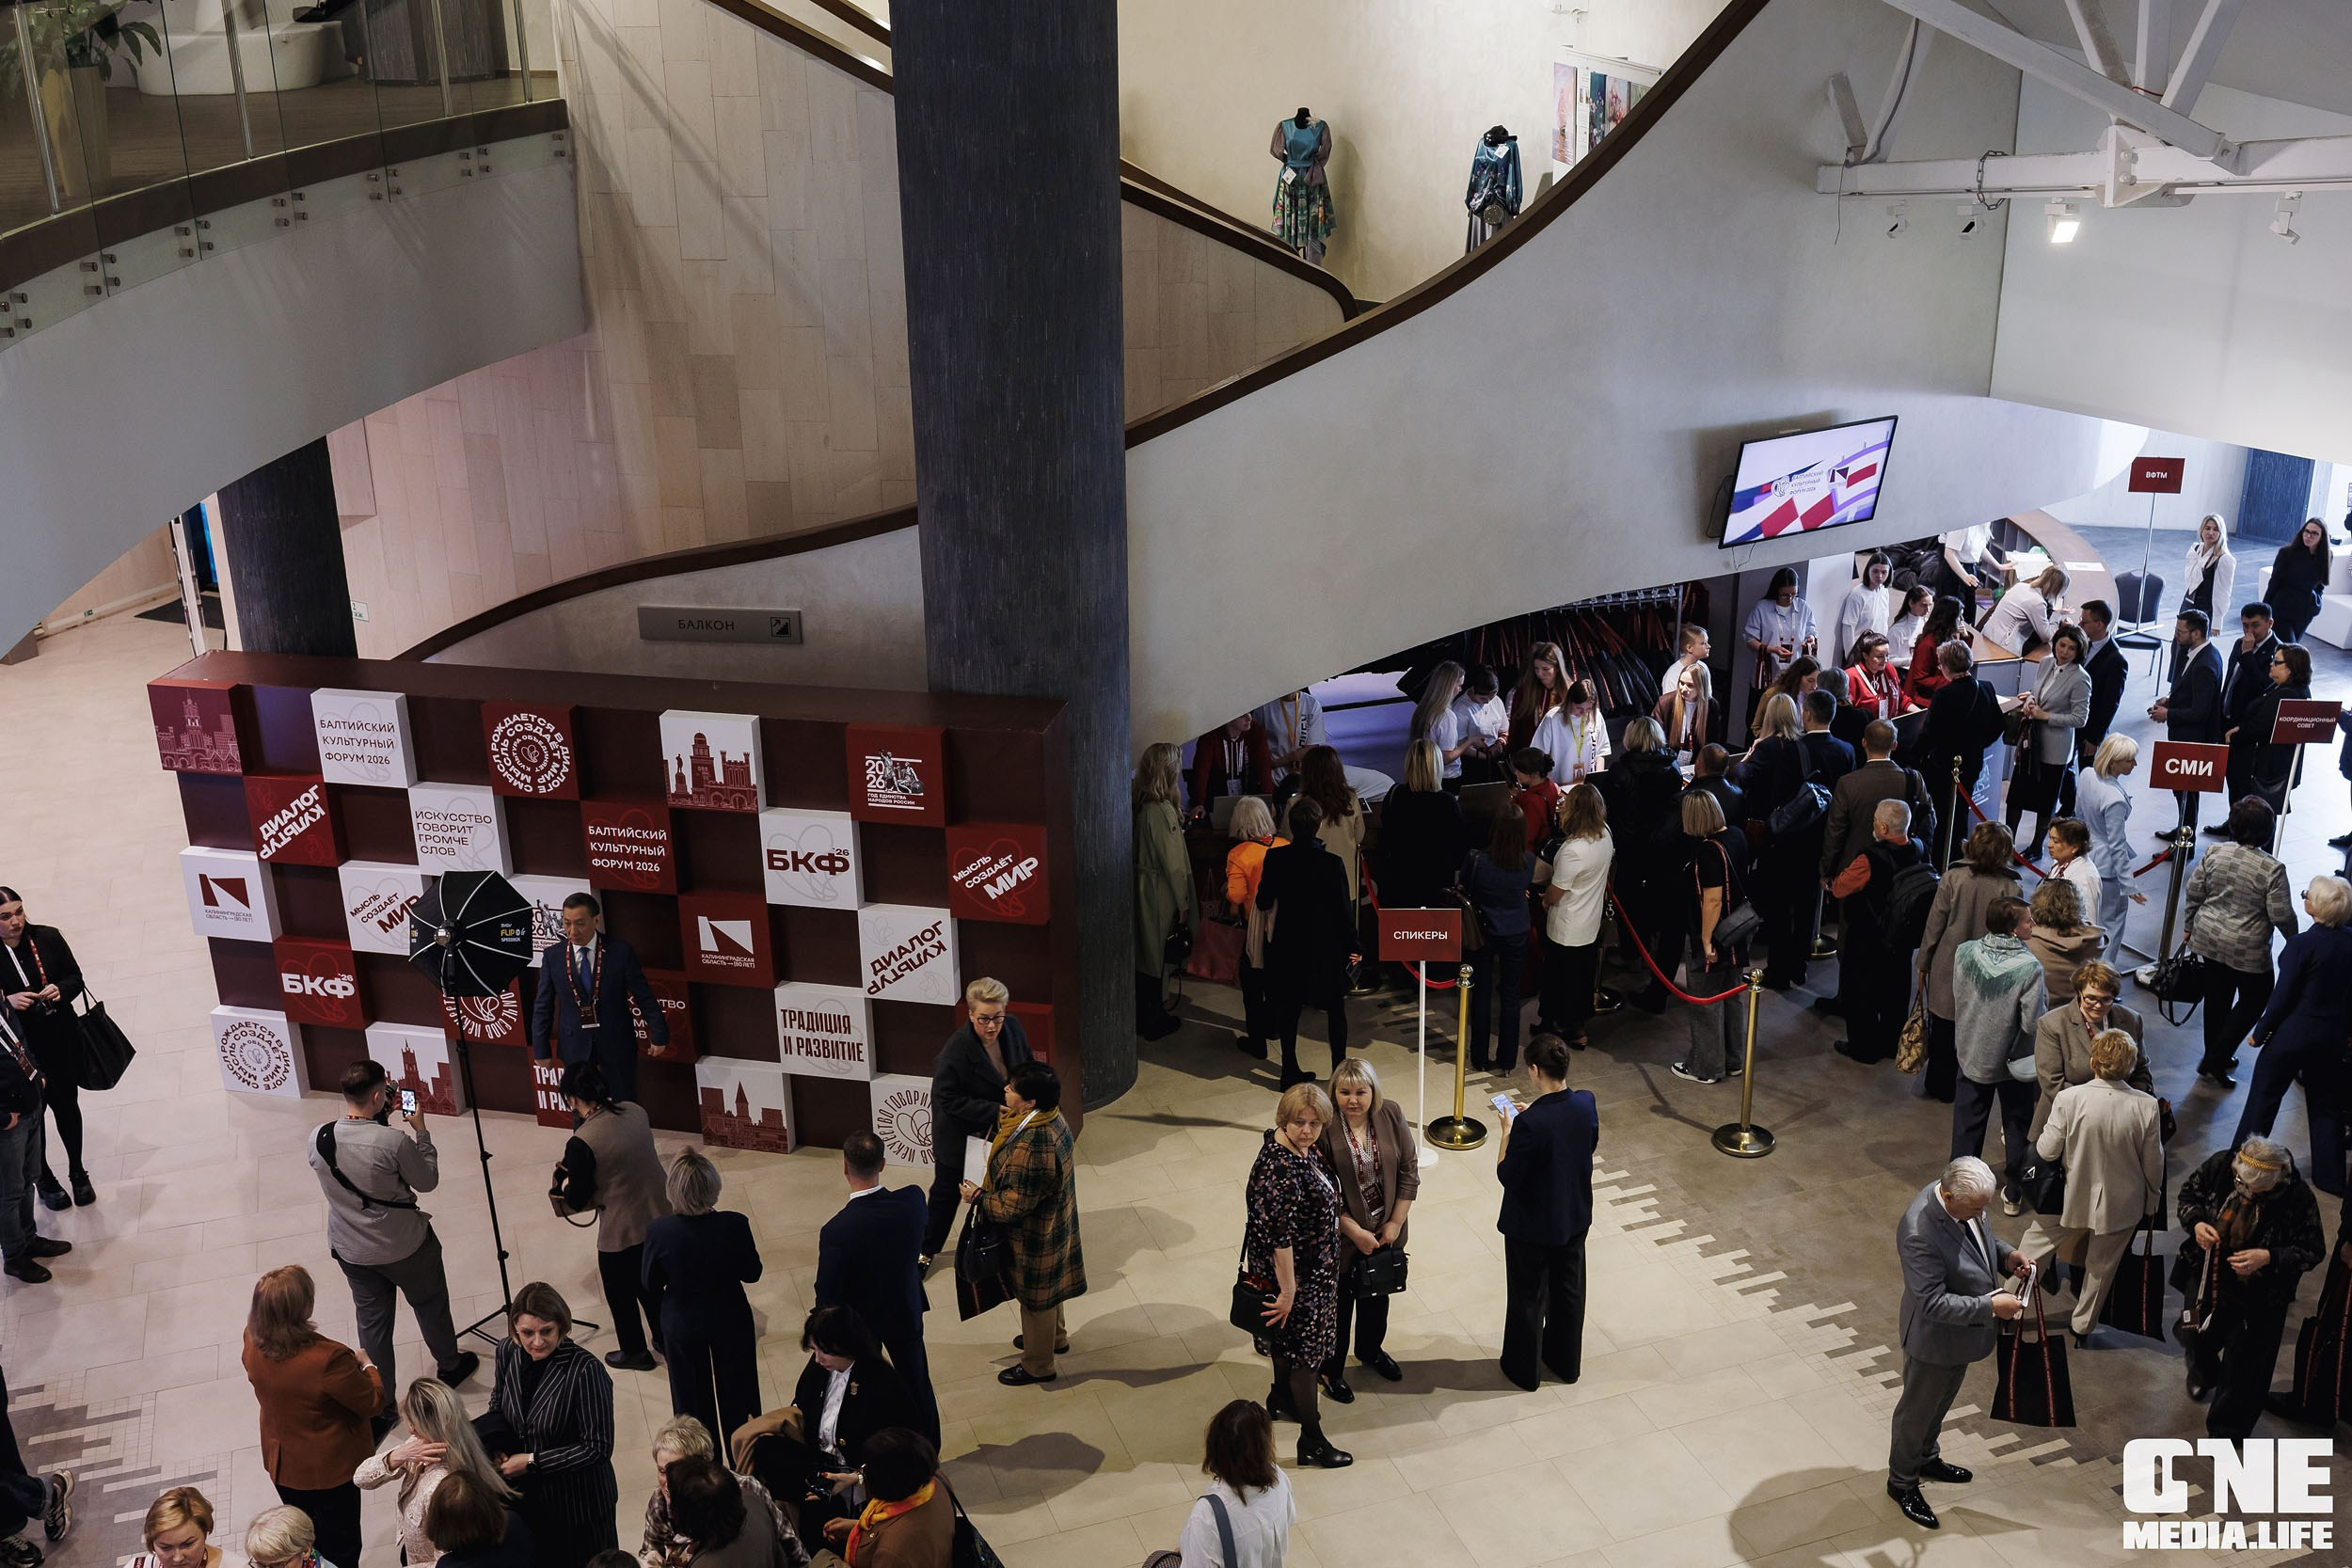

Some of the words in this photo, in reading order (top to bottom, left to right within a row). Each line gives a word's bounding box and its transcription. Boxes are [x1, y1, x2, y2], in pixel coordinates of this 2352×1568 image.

[2145, 470, 2168, 479] ВФТМ
[677, 619, 735, 631] БАЛКОН
[320, 720, 395, 734] БАЛТИЙСКИЙ
[491, 713, 555, 752] РОЖДАЕТСЯ
[554, 732, 564, 743] В
[322, 736, 395, 750] КУЛЬТУРНЫЙ
[325, 752, 365, 763] ФОРУМ
[367, 754, 390, 765] 2026
[501, 738, 532, 783] МЫСЛЬ
[537, 762, 560, 783] МИР
[537, 745, 570, 793] ДИАЛОГЕ
[866, 760, 885, 775] 20
[2165, 758, 2214, 776] СМИ
[493, 754, 532, 792] СМЫСЛ
[866, 774, 885, 789] 26
[259, 784, 320, 841] ДИАЛОГ
[415, 811, 492, 824] ИСКУССТВО
[260, 803, 326, 860] КУЛЬТУР
[417, 823, 473, 838] ГОВОРИТ
[419, 834, 469, 846] ГРОМЧЕ
[588, 826, 667, 841] БАЛТИЙСКИЙ
[421, 846, 456, 856] СЛОВ
[590, 842, 666, 856] КУЛЬТУРНЫЙ
[767, 848, 850, 876] БКФ
[592, 858, 634, 870] ФОРУМ
[636, 862, 660, 872] 2026
[952, 856, 992, 882] МЫСЛЬ
[965, 854, 1014, 889] СОЗДАЁТ
[983, 857, 1039, 900] МИР
[349, 894, 381, 917] МЫСЛЬ
[360, 893, 400, 924] СОЗДАЁТ
[870, 920, 943, 976] ДИАЛОГ
[1393, 930, 1448, 940] СПИКЕРЫ
[701, 954, 755, 963] КАЛИНИНГРАДСКАЯ
[866, 940, 947, 995] КУЛЬТУР
[281, 973, 355, 999] БКФ
[780, 1008, 851, 1035] ТРАДИЦИЯ
[220, 1021, 276, 1053] РОЖДАЕТСЯ
[275, 1038, 284, 1048] В
[783, 1035, 793, 1055] И
[796, 1037, 865, 1062] РАЗВИТИЕ
[222, 1055, 260, 1089] СМЫСЛ
[229, 1042, 258, 1081] МЫСЛЬ
[262, 1064, 281, 1082] МИР
[263, 1051, 291, 1091] ДИАЛОГЕ
[877, 1108, 916, 1164] ИСКУССТВО
